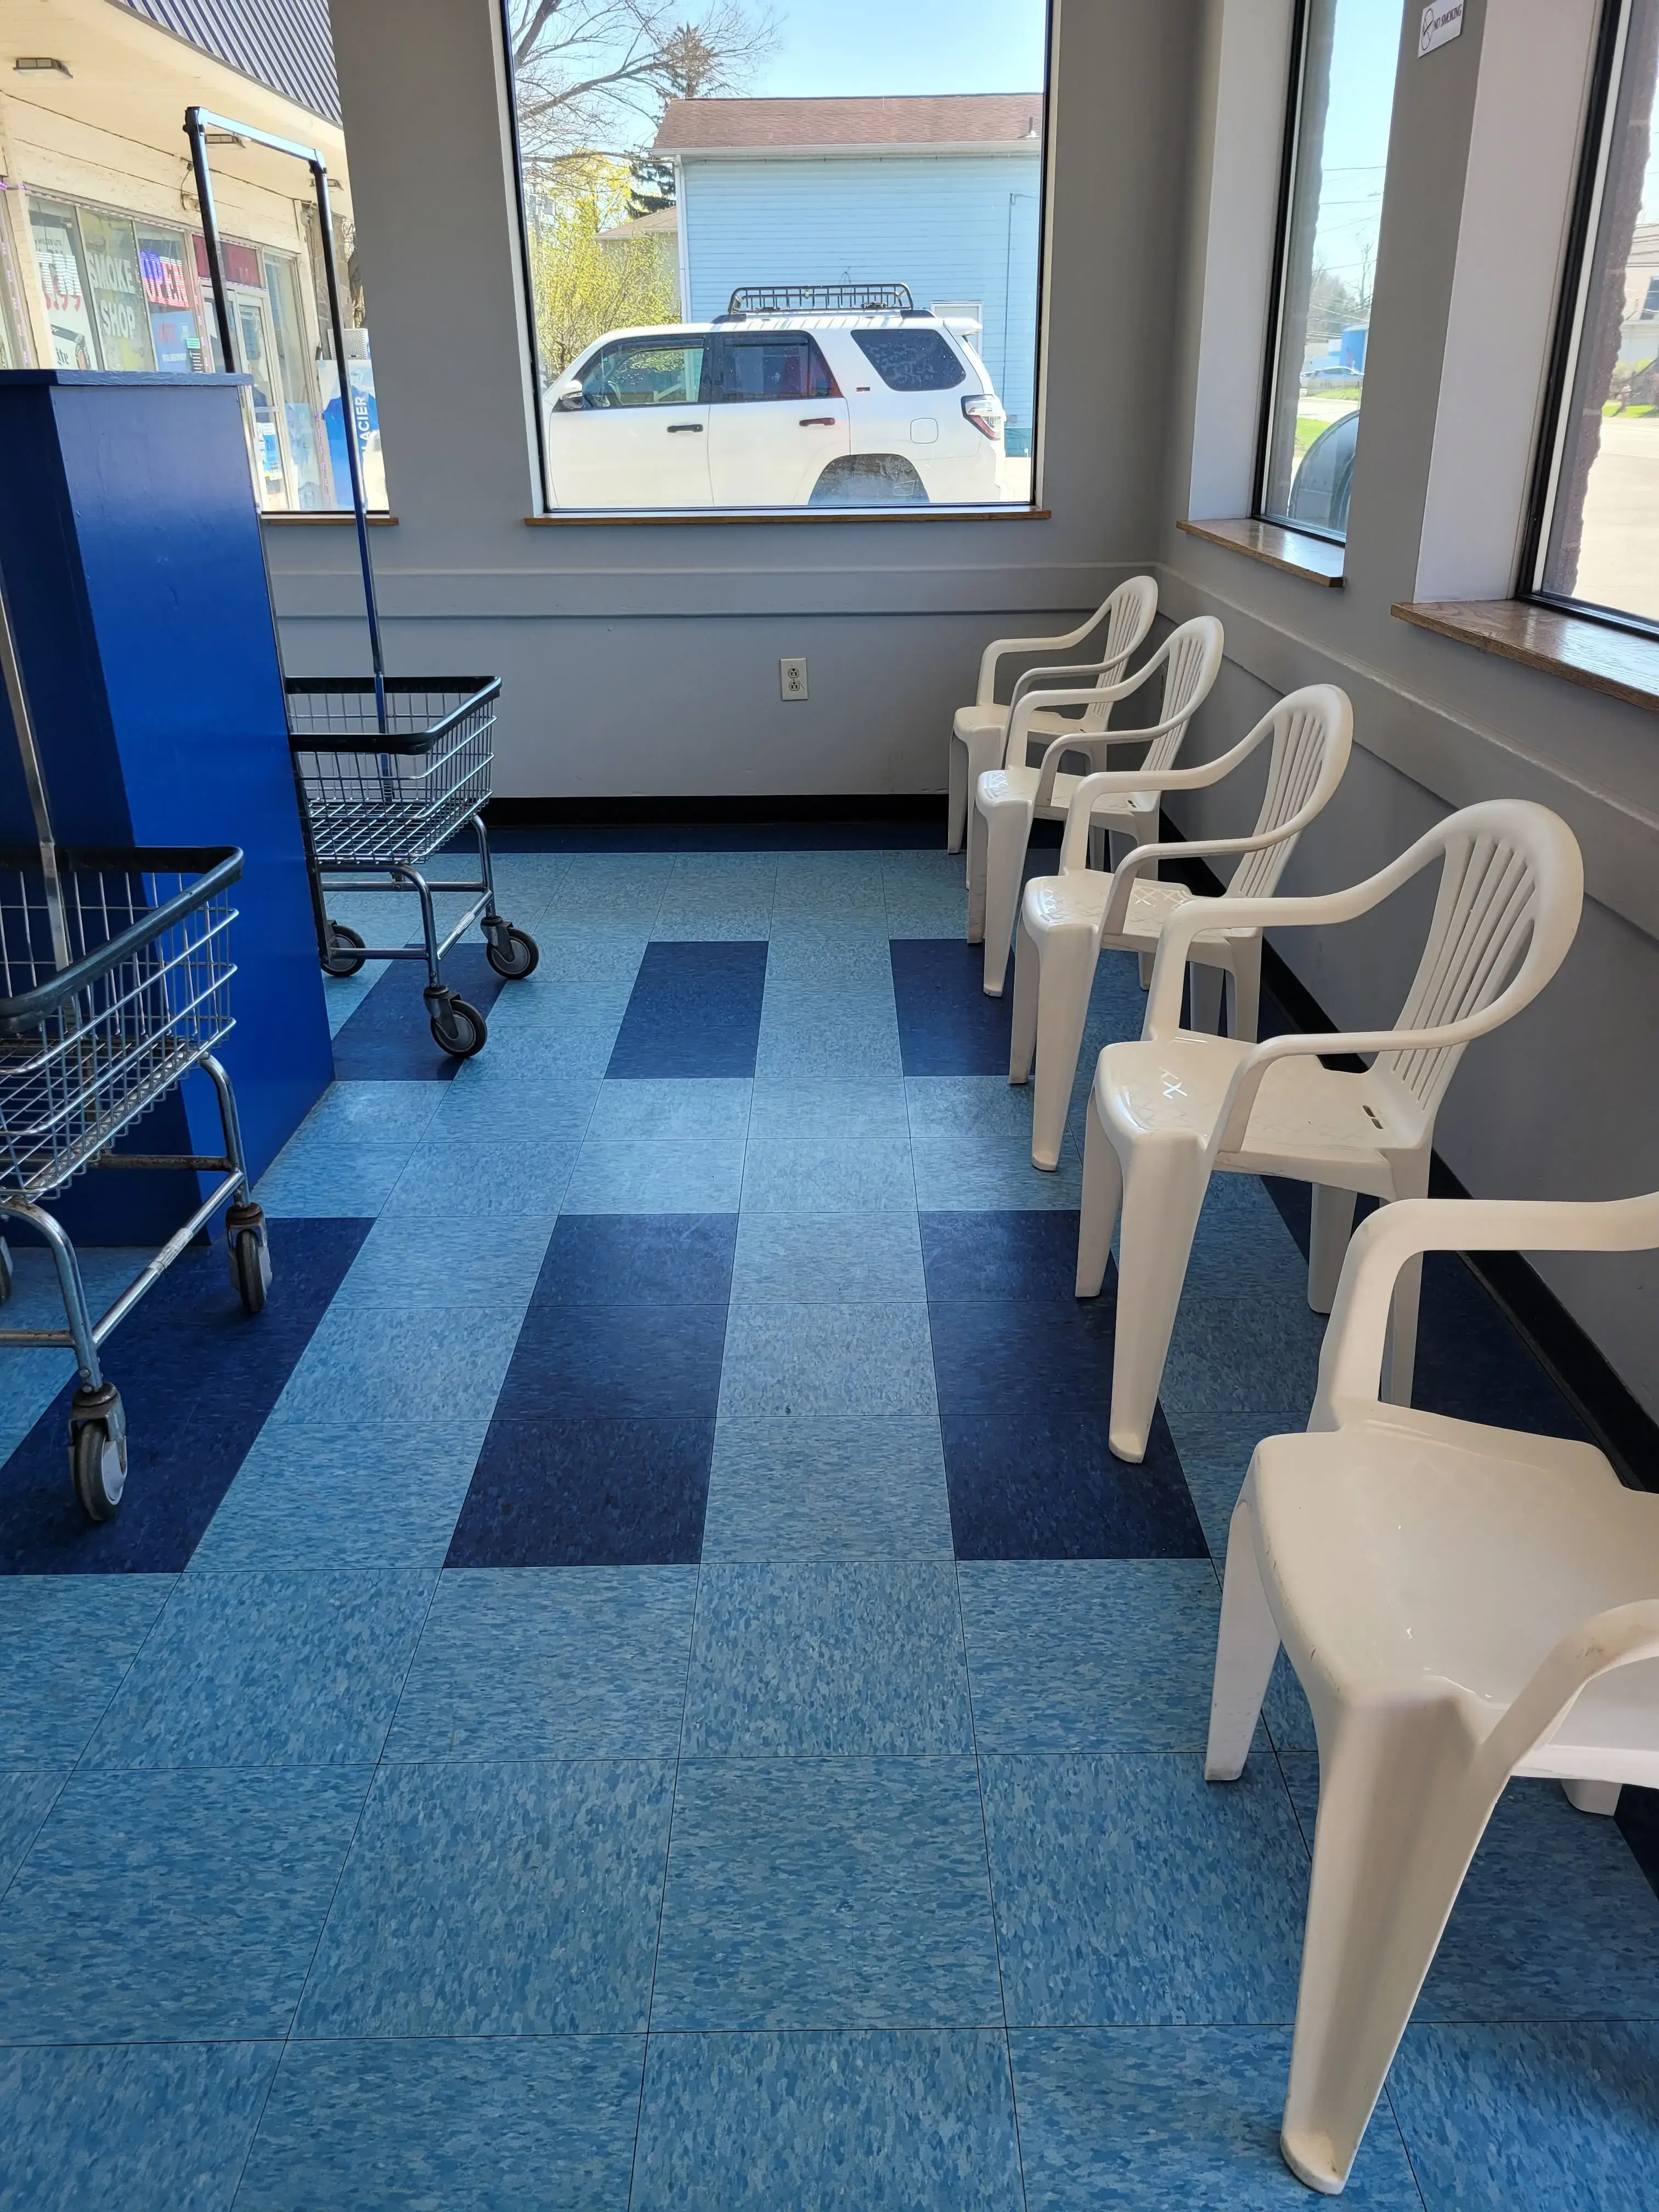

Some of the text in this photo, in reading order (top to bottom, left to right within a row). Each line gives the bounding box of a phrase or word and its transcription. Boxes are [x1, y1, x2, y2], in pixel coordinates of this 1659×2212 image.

[1441, 4, 1462, 27] SMOKING
[86, 251, 137, 294] SMOKE
[139, 250, 189, 308] OPEN
[100, 300, 137, 340] SHOP
[355, 396, 371, 450] ACIER
